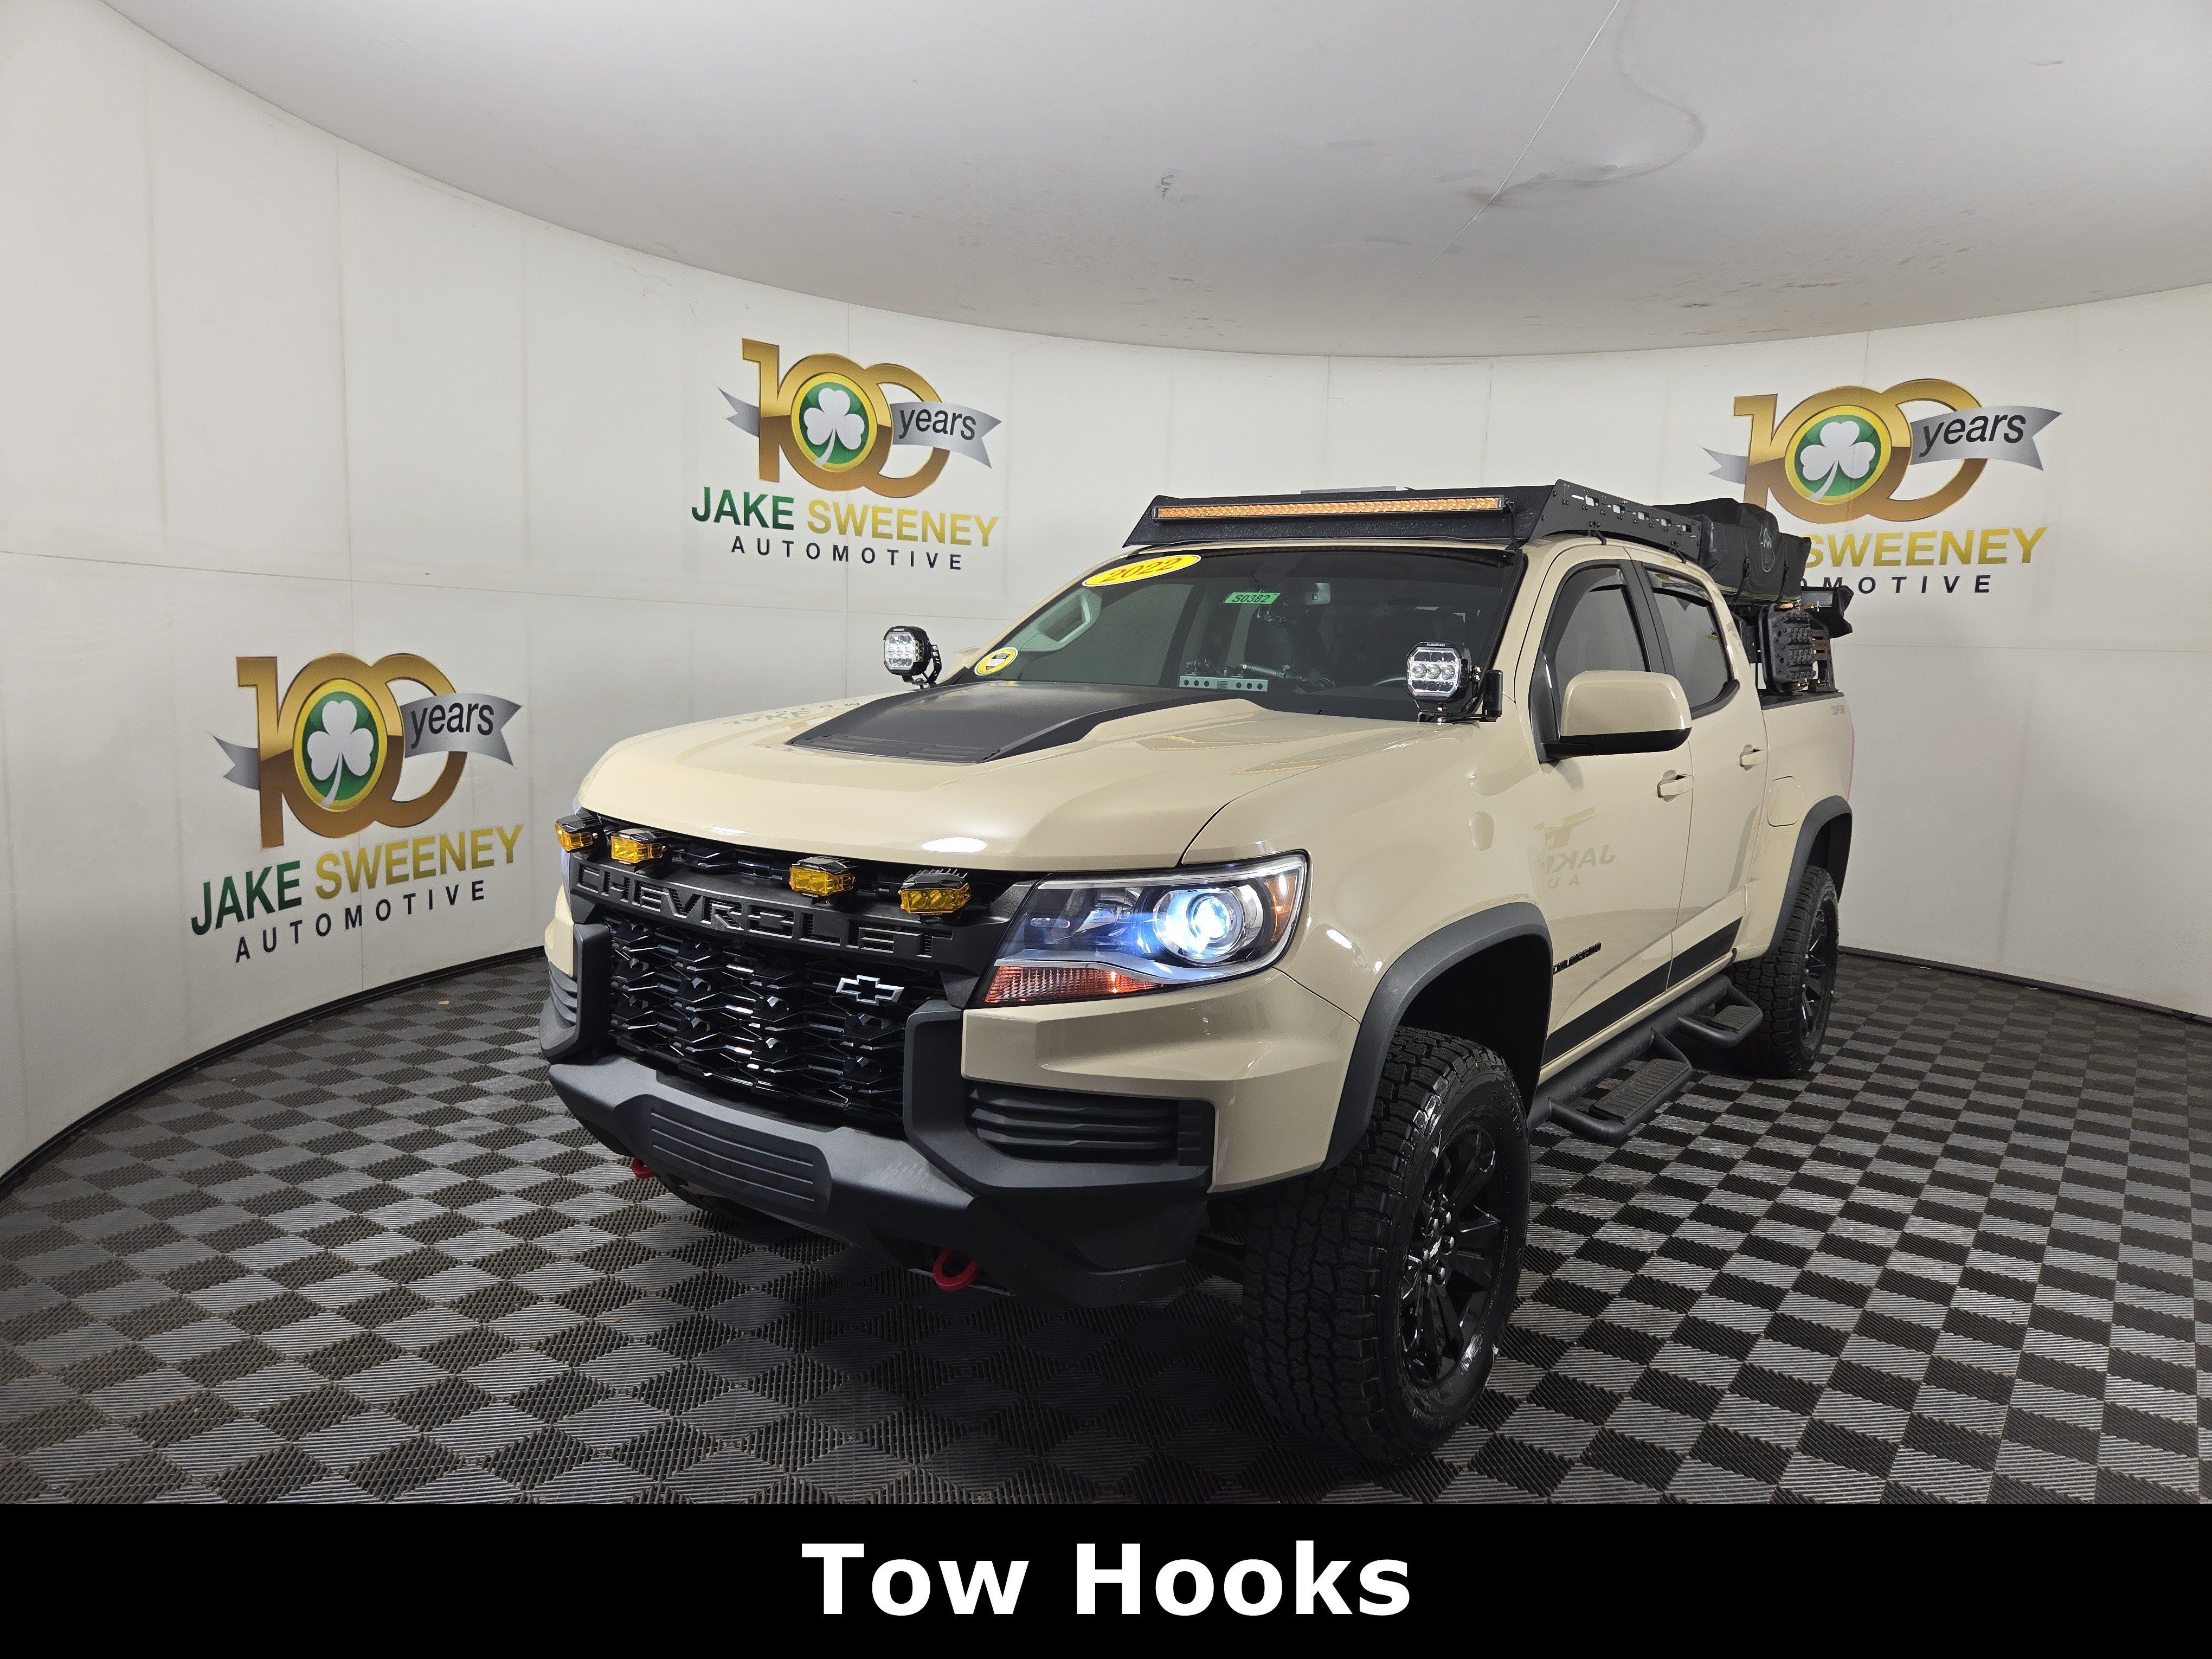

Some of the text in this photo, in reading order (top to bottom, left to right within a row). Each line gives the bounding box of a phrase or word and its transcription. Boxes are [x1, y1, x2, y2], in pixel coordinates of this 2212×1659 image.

[742, 337, 976, 499] 100 years
[1733, 378, 2027, 525] 100 years
[691, 486, 1000, 547] JAKE SWEENEY
[731, 536, 962, 570] AUTOMOTIVE
[1099, 558, 1183, 583] 2022
[1232, 594, 1271, 603] S0382
[236, 653, 494, 850] 100 years
[191, 824, 524, 936] JAKE SWEENEY
[235, 879, 486, 963] AUTOMOTIVE
[577, 863, 954, 958] CHEVROLET
